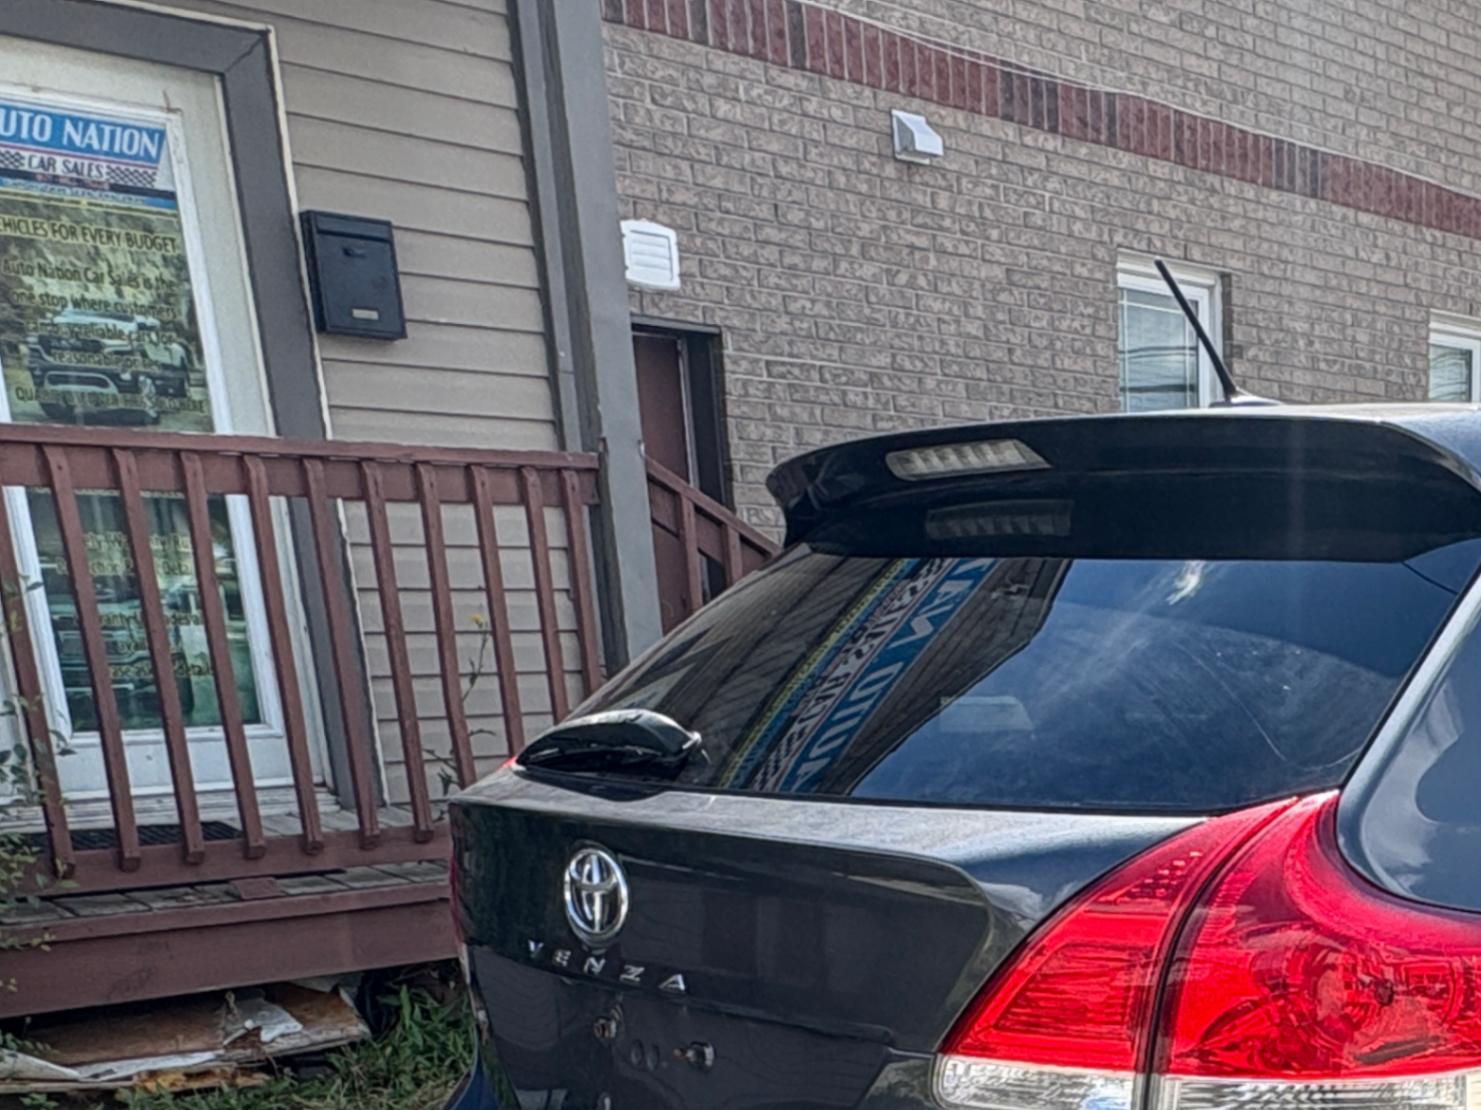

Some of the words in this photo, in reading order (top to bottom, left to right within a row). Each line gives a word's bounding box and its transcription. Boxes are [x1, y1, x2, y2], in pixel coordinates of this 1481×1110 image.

[63, 116, 160, 160] NATION
[28, 154, 56, 173] CAR
[62, 159, 104, 180] SALES
[52, 222, 78, 240] FOR
[82, 226, 122, 247] EVERY
[126, 232, 177, 253] BUDGET
[3, 259, 35, 277] Auto
[38, 262, 82, 281] Nation
[84, 266, 105, 284] Car
[109, 269, 140, 288] Sales
[528, 940, 687, 993] VENZA
